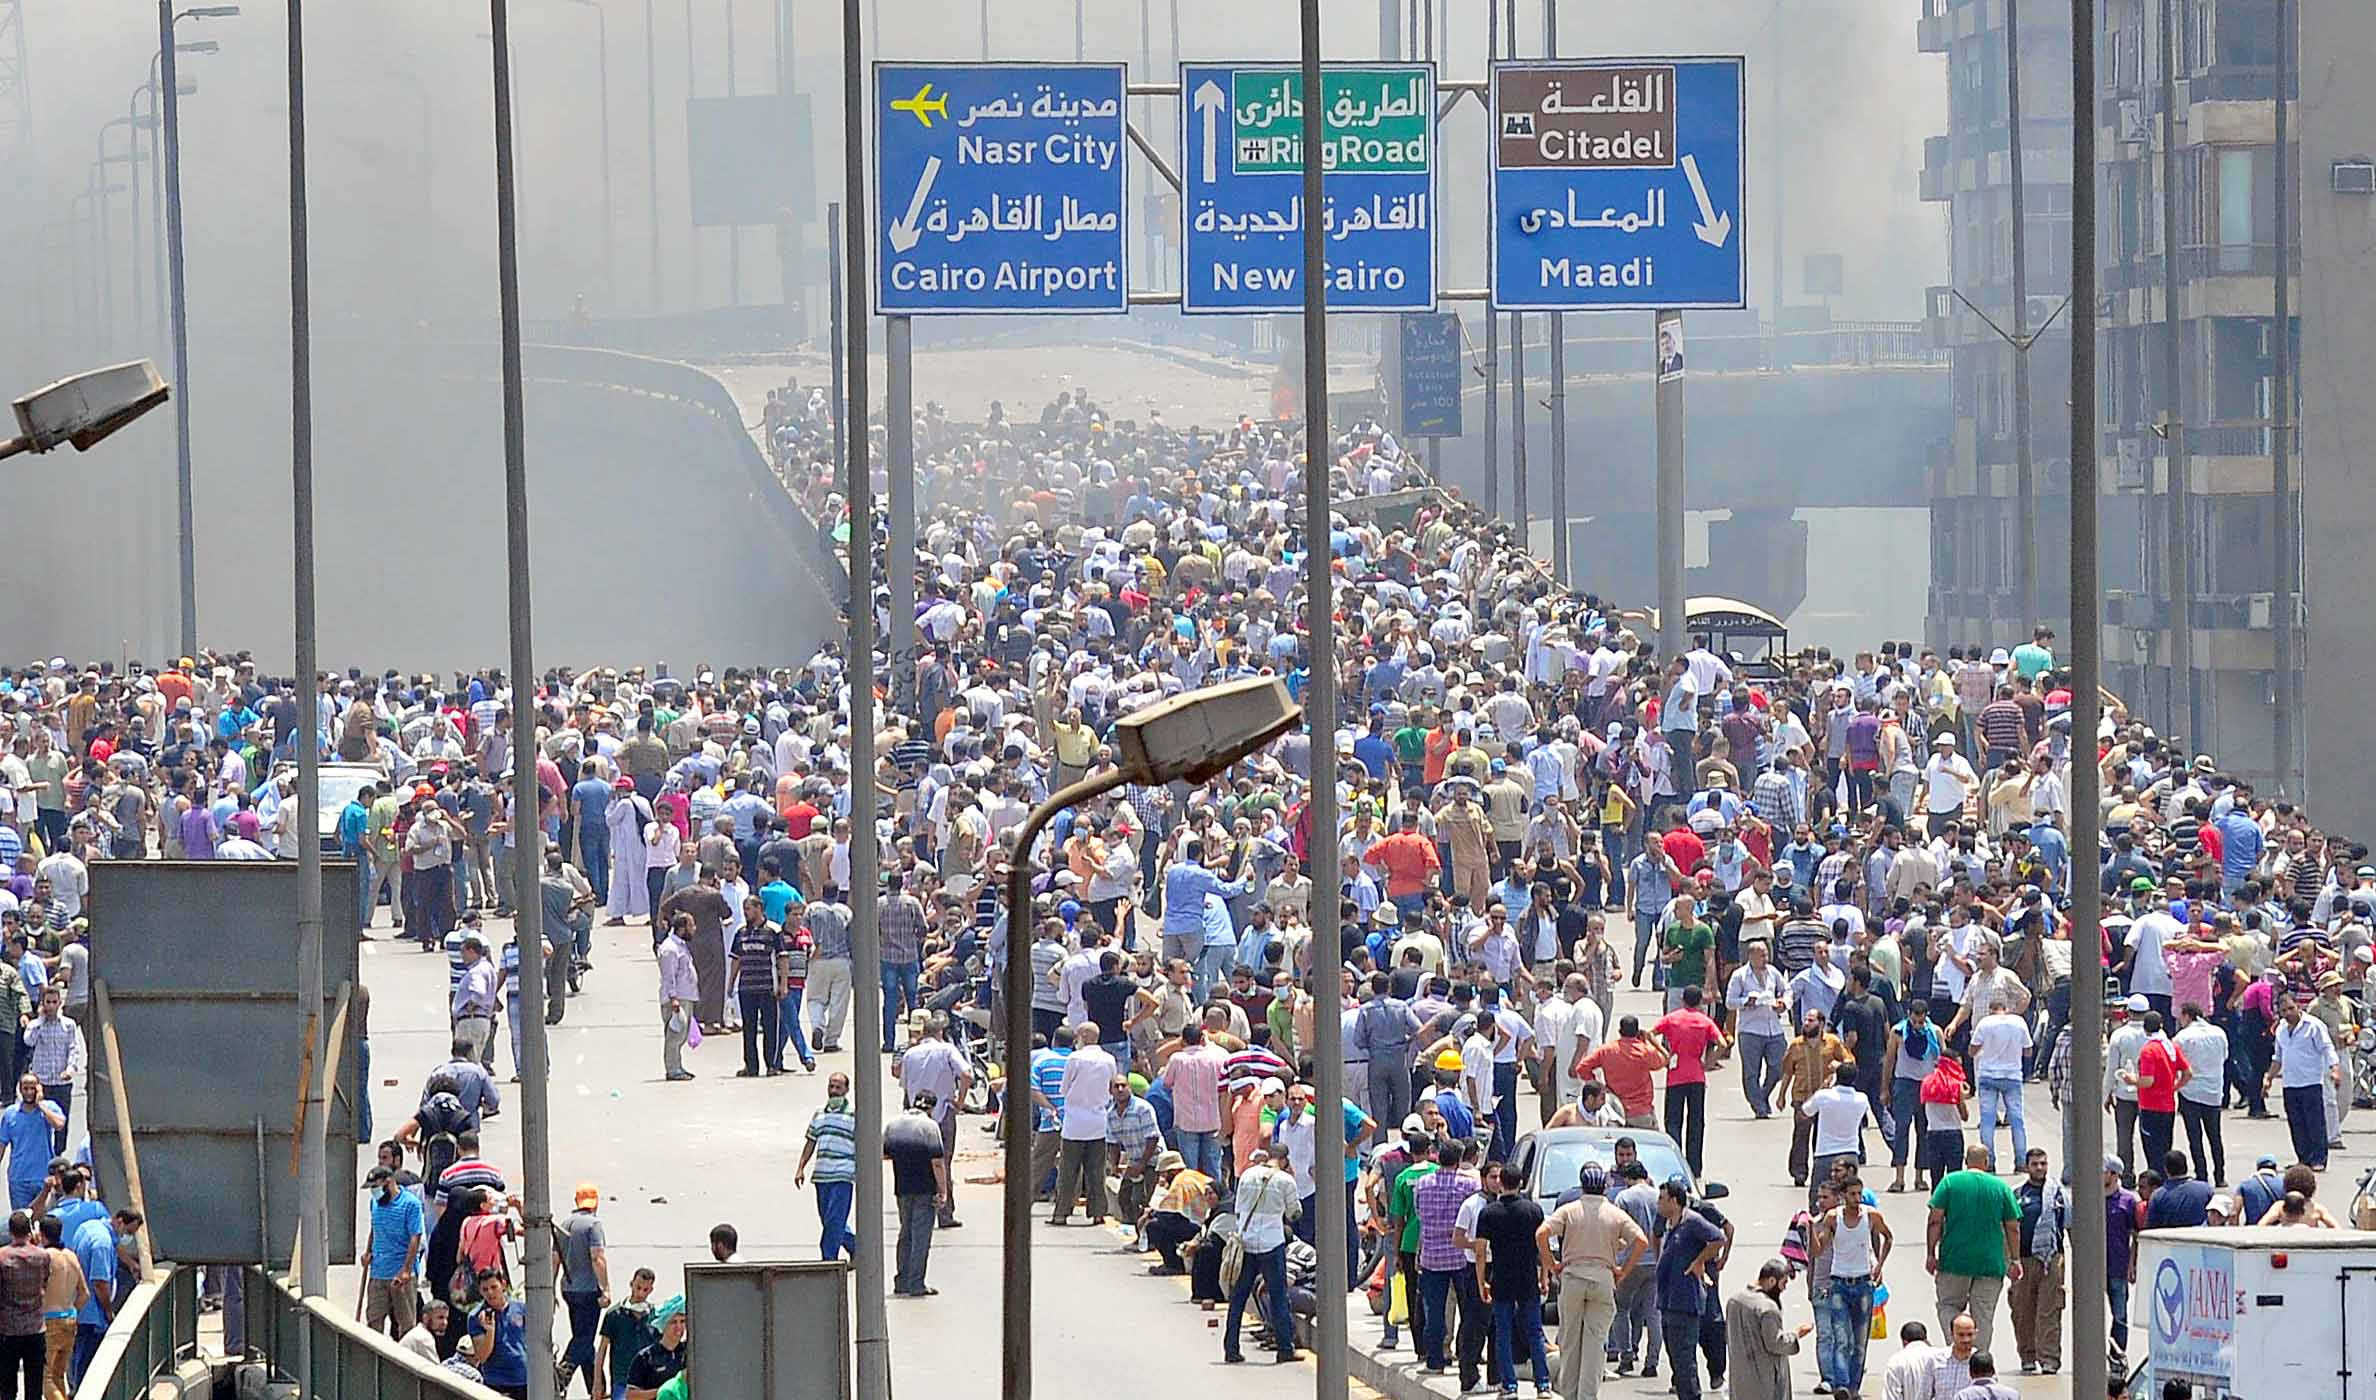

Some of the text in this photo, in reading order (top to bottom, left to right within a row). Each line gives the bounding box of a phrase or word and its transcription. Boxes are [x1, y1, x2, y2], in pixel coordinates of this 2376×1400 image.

[957, 85, 1118, 127] مدينة نصر
[1235, 77, 1426, 128] الطريق دائرى
[1541, 74, 1664, 114] القلعة
[957, 133, 1117, 171] Nasr City
[1271, 134, 1337, 169] Rig
[1539, 129, 1665, 160] Citadel
[926, 193, 1118, 242] مطار القاهرة
[1322, 193, 1426, 241] القاهرة
[1520, 187, 1665, 233] المعادى
[891, 261, 1117, 297] Cairo Airport
[1213, 262, 1296, 291] New
[1540, 257, 1653, 288] Maadi
[1432, 396, 1455, 408] 100
[1687, 616, 1711, 627] القاهر
[2185, 1268, 2230, 1331] JANA
